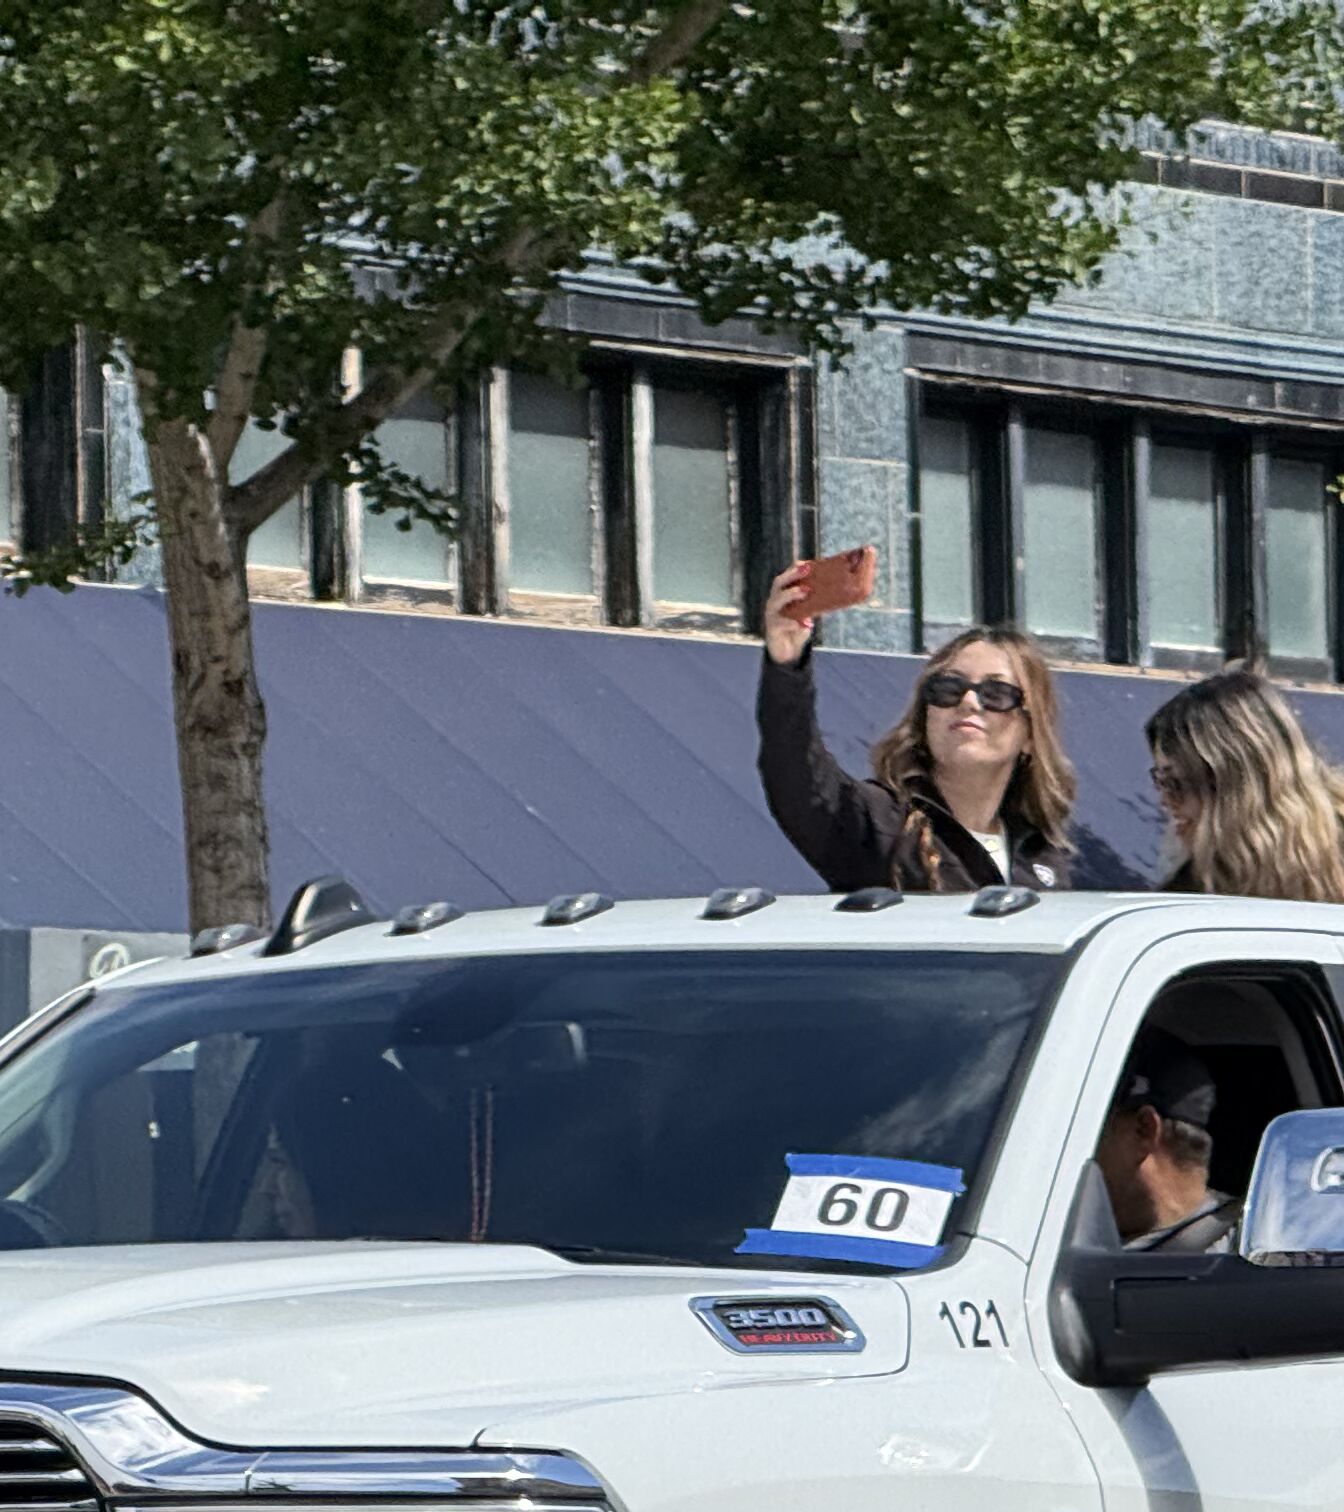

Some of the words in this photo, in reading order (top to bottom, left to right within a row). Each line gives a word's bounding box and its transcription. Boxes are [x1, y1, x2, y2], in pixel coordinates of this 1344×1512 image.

[817, 1182, 910, 1232] 60
[724, 1308, 827, 1328] 3500
[939, 1299, 1010, 1348] 121
[739, 1332, 792, 1344] HEAVY
[794, 1332, 838, 1343] DUTY
